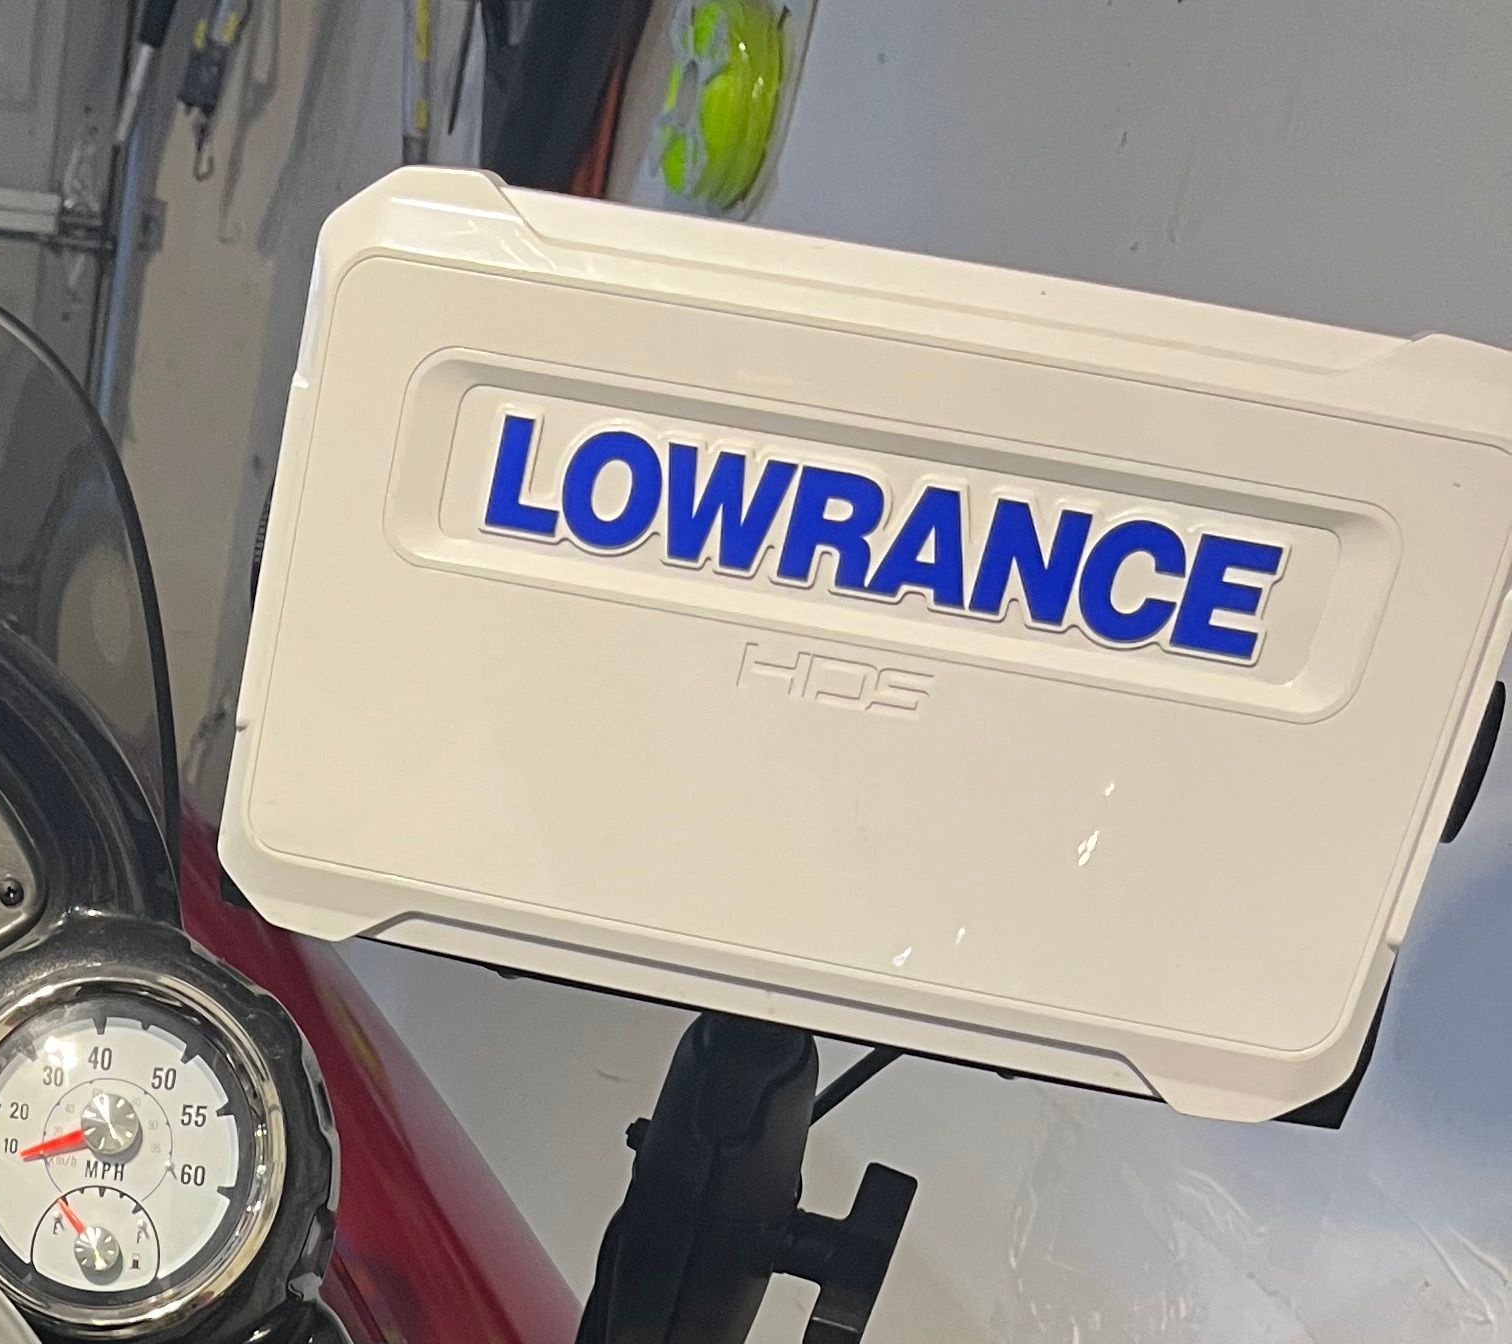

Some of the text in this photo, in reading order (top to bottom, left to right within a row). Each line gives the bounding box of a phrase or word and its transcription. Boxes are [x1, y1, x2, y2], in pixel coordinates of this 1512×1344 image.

[483, 416, 1284, 661] LOWRANCE
[736, 641, 934, 719] HDS
[88, 1046, 113, 1071] 40
[43, 1065, 64, 1087] 30
[151, 1067, 176, 1091] 50
[9, 1102, 29, 1120] 20
[180, 1104, 208, 1128] 55
[3, 1137, 18, 1154] 10
[85, 1160, 125, 1182] MPH
[180, 1165, 206, 1186] 60
